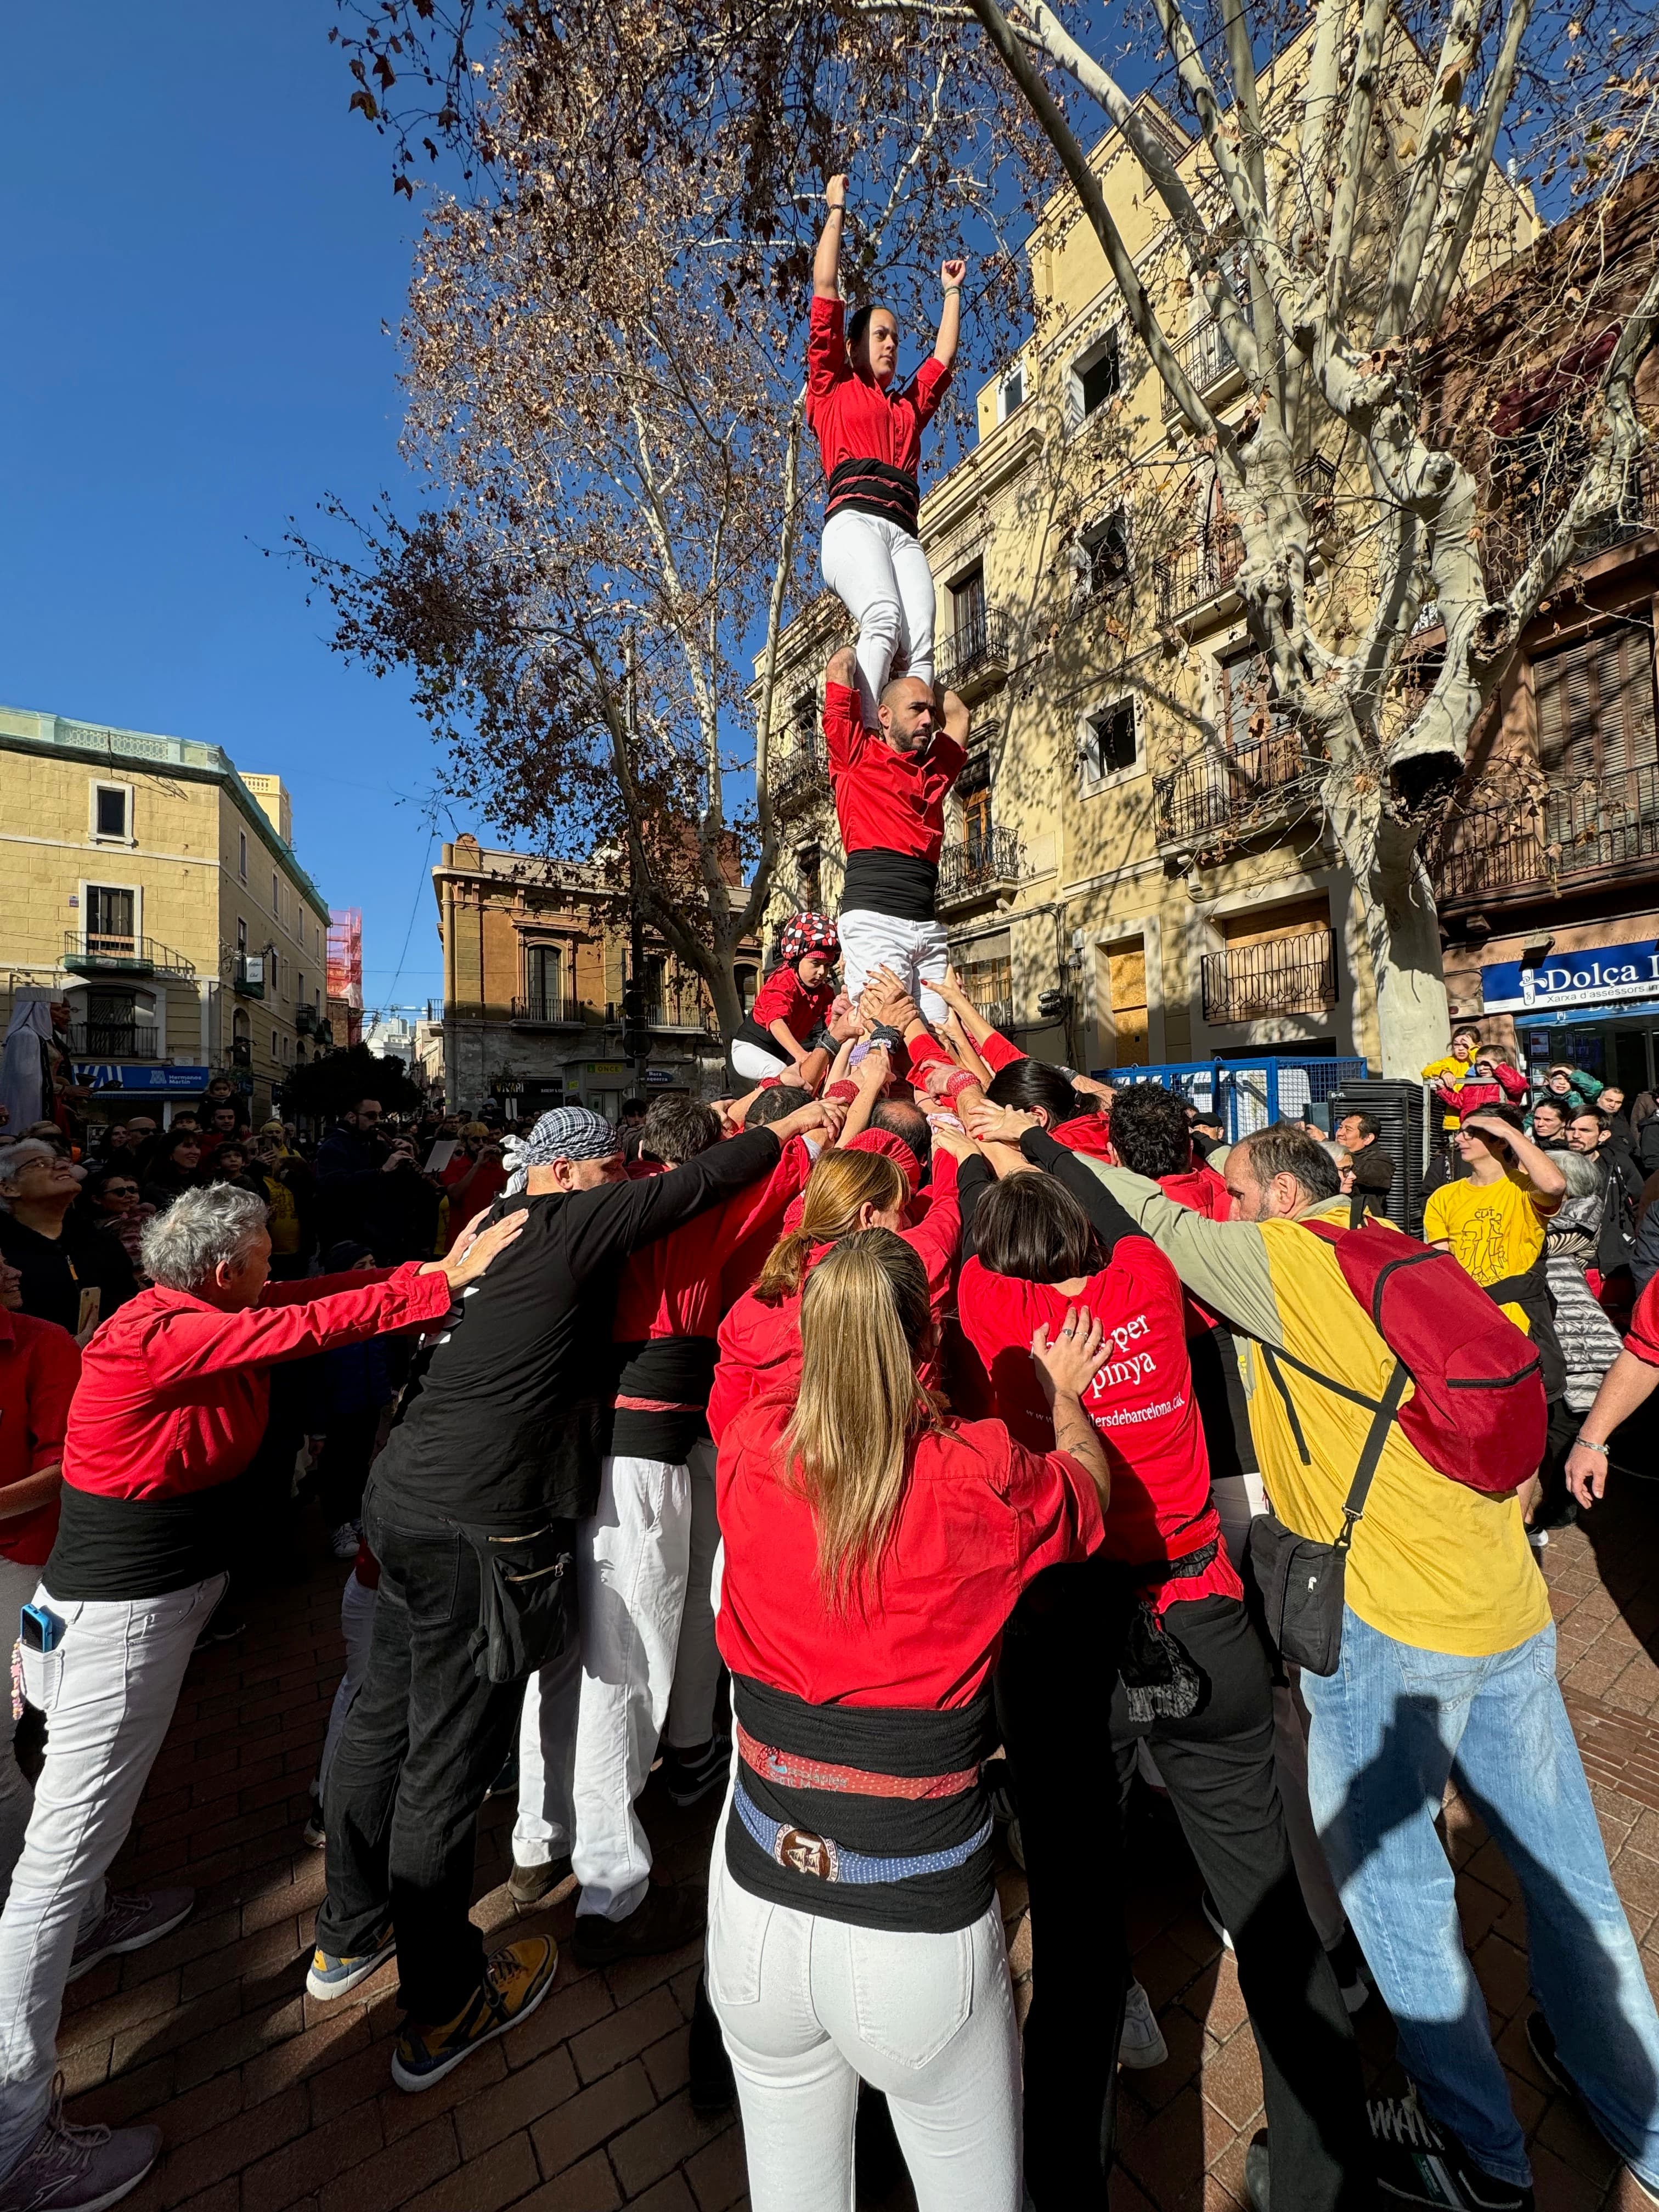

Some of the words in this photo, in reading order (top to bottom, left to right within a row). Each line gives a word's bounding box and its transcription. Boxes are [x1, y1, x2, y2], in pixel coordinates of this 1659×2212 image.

[1544, 962, 1639, 991] Dolça
[1547, 994, 1577, 1003] Xarxa
[1580, 985, 1645, 999] d'assessors
[1111, 1314, 1150, 1353] per
[1092, 1352, 1156, 1398] pinya
